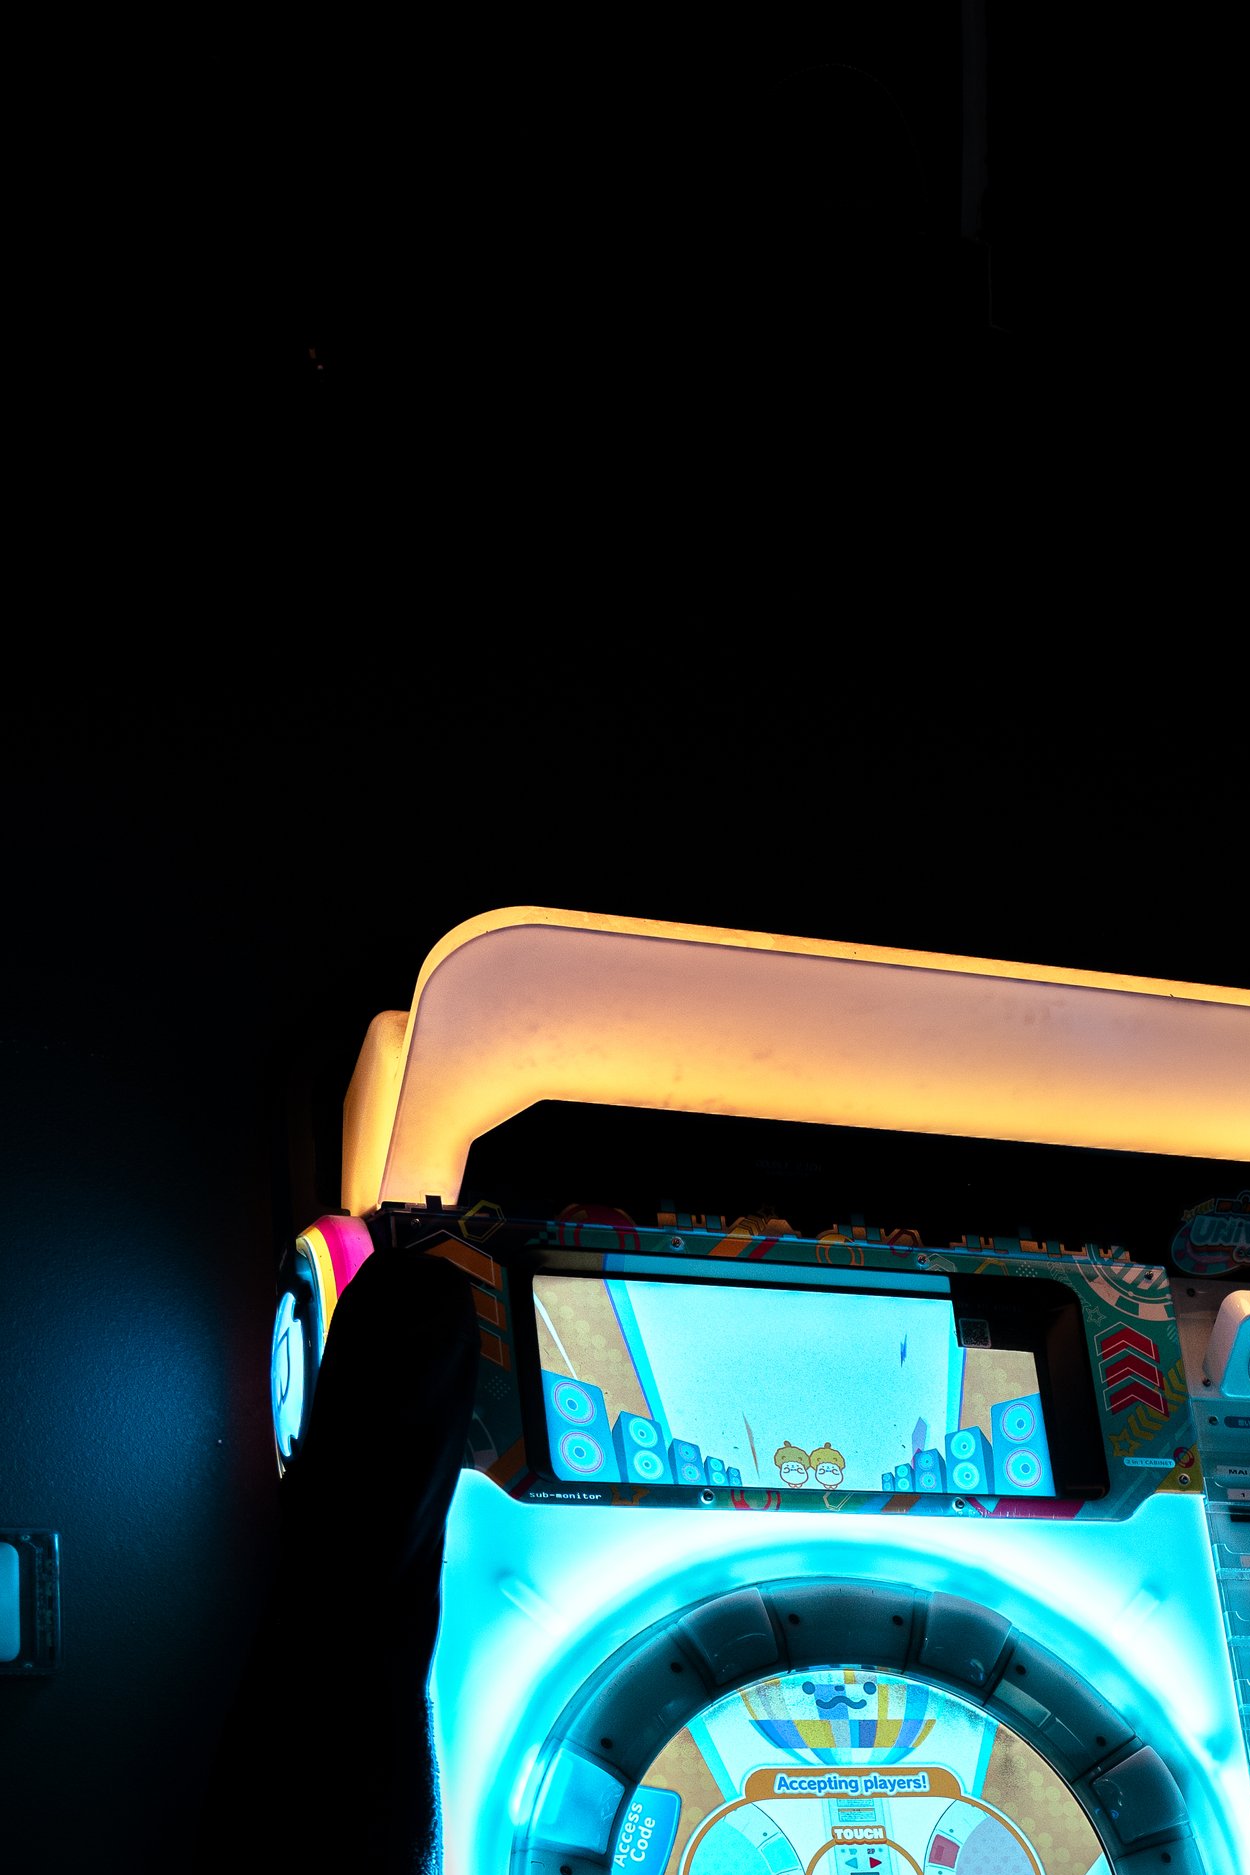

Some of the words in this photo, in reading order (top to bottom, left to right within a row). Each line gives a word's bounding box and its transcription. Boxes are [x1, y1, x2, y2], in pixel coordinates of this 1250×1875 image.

[529, 1492, 602, 1500] sub-monitor
[777, 1775, 859, 1795] Accepting
[863, 1774, 927, 1793] players!
[613, 1801, 643, 1868] Access
[630, 1815, 656, 1863] Code
[833, 1828, 884, 1840] TOUCH
